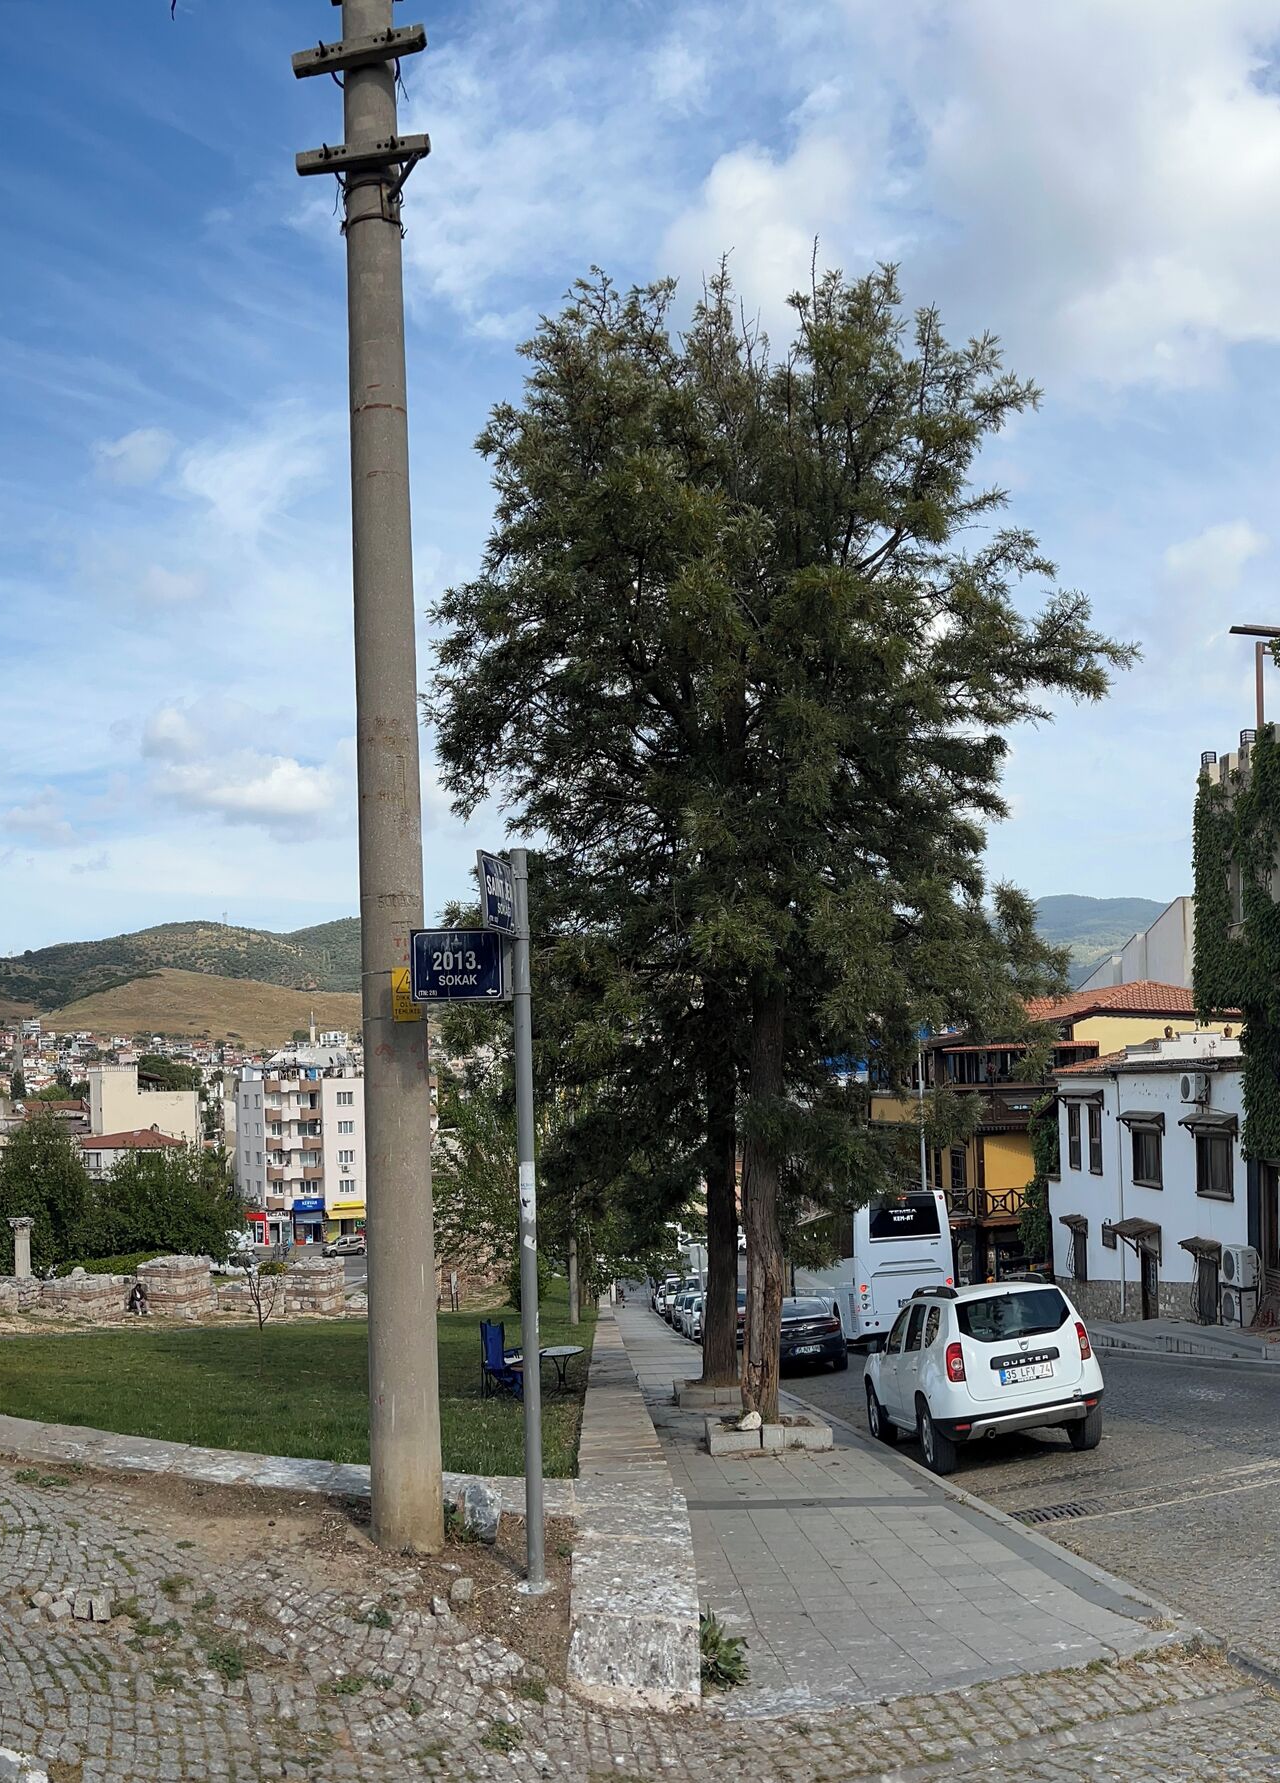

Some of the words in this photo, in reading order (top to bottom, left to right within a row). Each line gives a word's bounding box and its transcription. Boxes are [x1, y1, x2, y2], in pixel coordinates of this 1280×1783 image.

[486, 874, 504, 899] SAINT
[432, 950, 482, 971] 2013.
[438, 974, 478, 986] SOKAK
[1002, 1354, 1049, 1367] DUSTER
[1006, 1369, 1017, 1380] 35
[1020, 1366, 1036, 1377] LFY
[1040, 1363, 1051, 1374] 74
